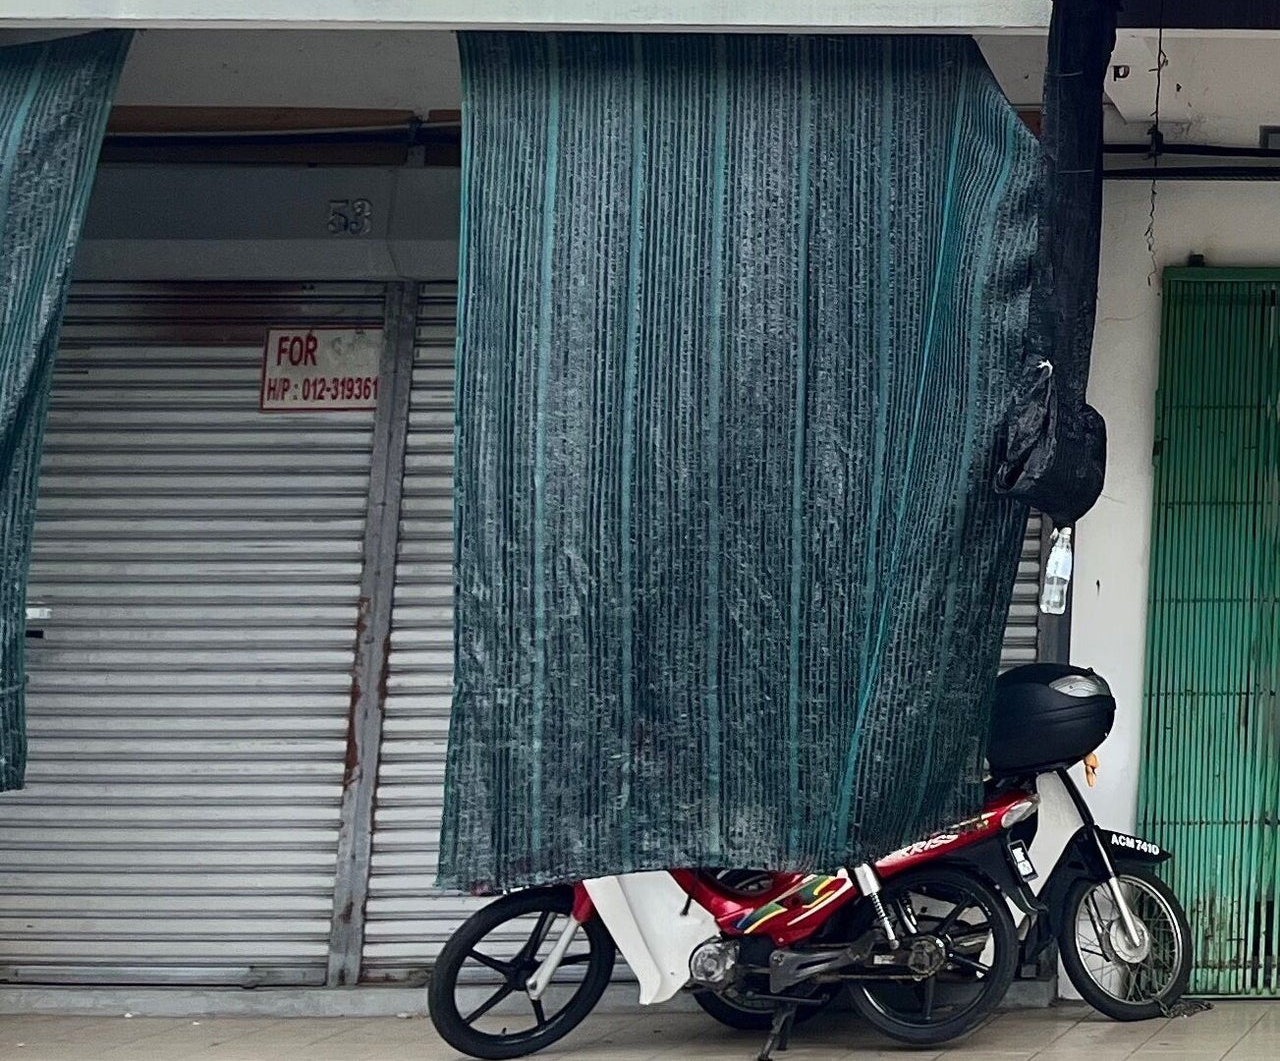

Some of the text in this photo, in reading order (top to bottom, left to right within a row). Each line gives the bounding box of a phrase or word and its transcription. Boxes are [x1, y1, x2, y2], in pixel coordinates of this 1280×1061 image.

[326, 198, 375, 235] 53
[276, 335, 318, 366] FOR
[1111, 833, 1135, 849] ACM
